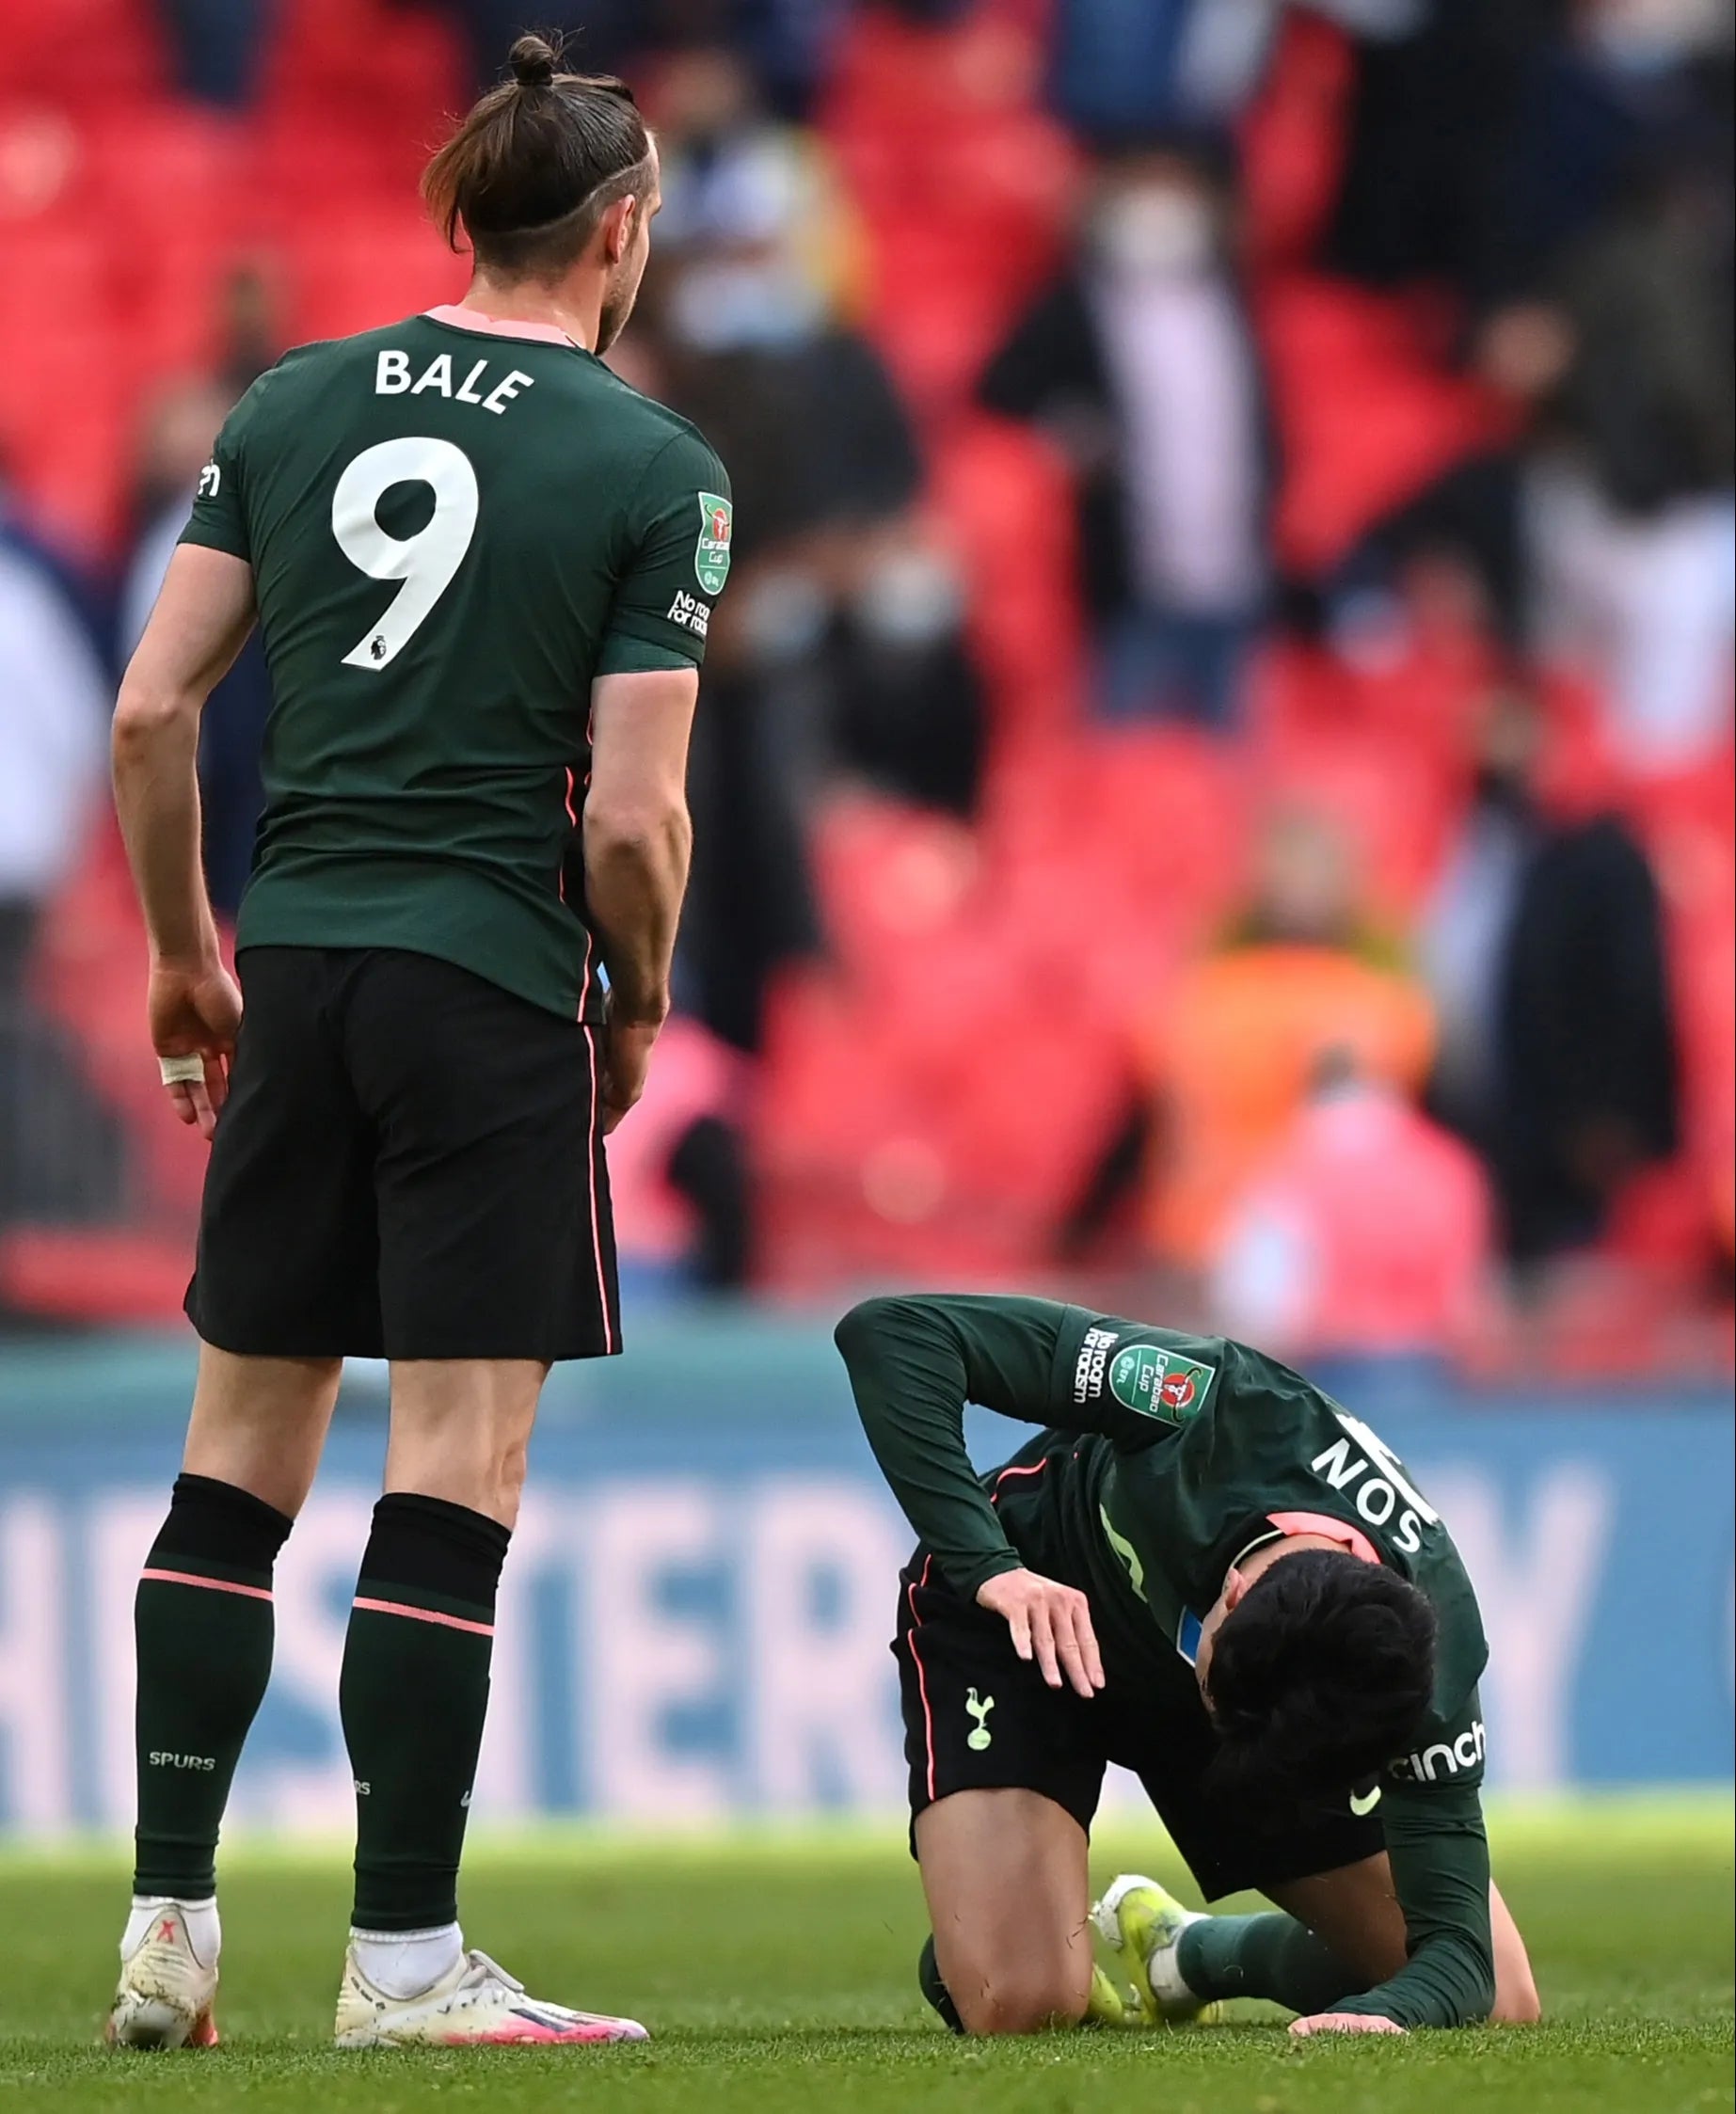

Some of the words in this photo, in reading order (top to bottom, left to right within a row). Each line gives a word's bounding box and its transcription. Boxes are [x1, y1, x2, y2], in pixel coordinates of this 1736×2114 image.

[376, 350, 534, 414] BALE
[332, 437, 479, 671] 9
[709, 550, 723, 564] Cup
[674, 590, 696, 612] No
[1074, 1348, 1092, 1404] racism
[1088, 1349, 1107, 1398] room
[1139, 1364, 1155, 1392] Cup
[1149, 1354, 1169, 1412] Carabao
[1311, 1438, 1422, 1552] SON
[150, 1751, 216, 1771] SPURS
